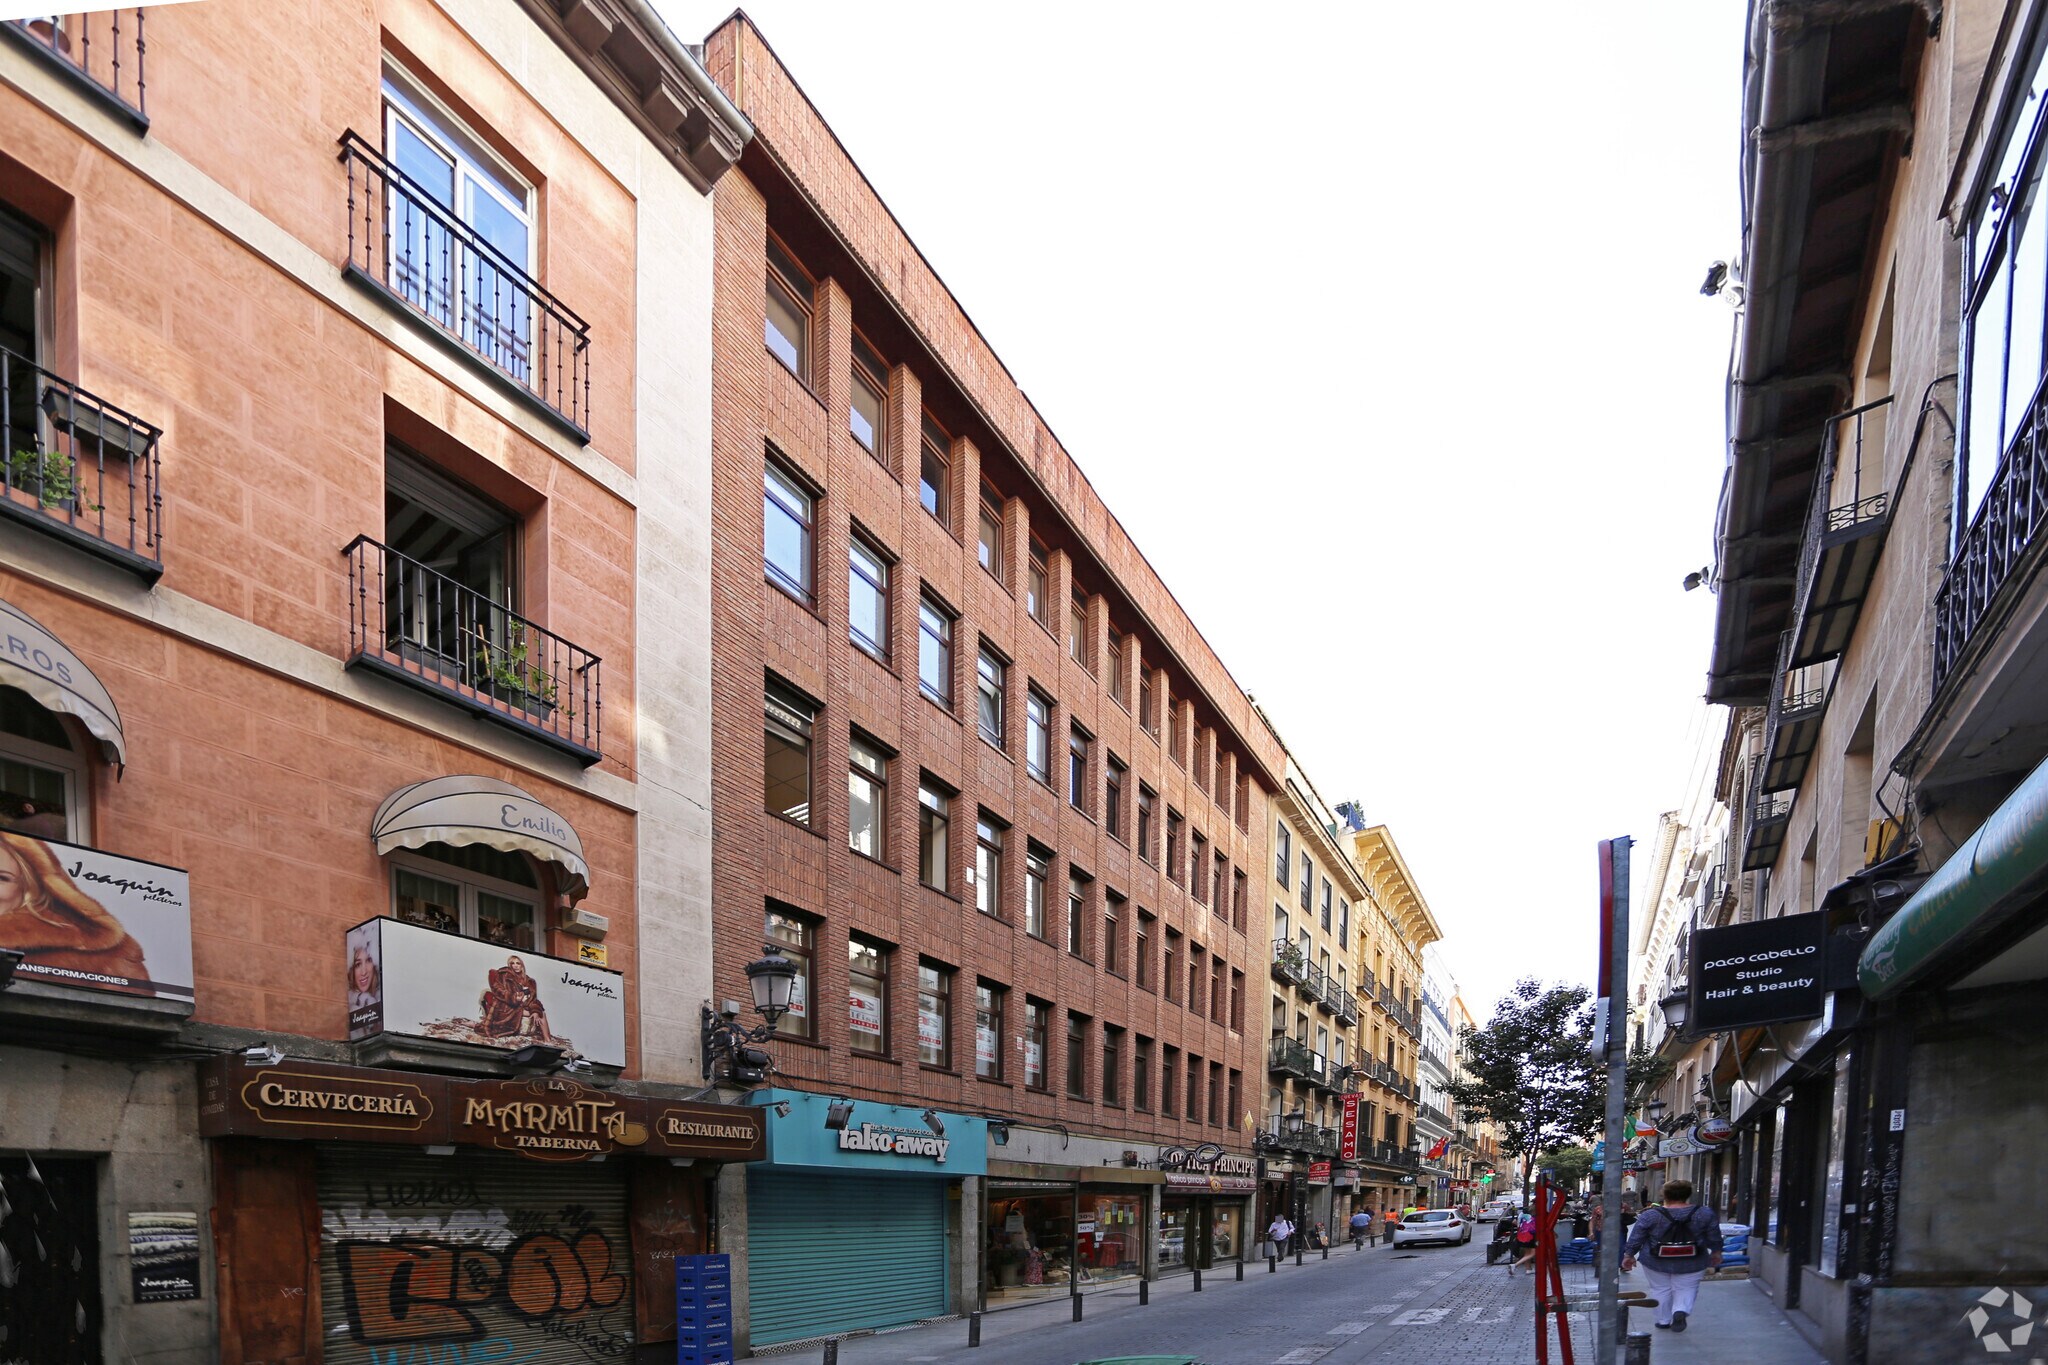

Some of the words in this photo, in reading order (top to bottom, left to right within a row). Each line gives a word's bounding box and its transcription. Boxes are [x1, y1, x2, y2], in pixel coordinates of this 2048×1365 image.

[0, 634, 72, 684] ROS
[501, 804, 567, 841] Emilio
[68, 861, 174, 897] Joaquin
[143, 893, 183, 907] peleteros
[561, 972, 613, 994] Joaquin
[1736, 967, 1783, 980] Studio
[1705, 988, 1738, 1000] Hair
[1742, 985, 1754, 995] &
[1758, 978, 1814, 993] beauty
[549, 1080, 565, 1092] LA
[259, 1082, 419, 1117] CERVECERÍA
[463, 1097, 627, 1140] MARMITA
[667, 1117, 754, 1140] RESTAURANTE
[1343, 1100, 1356, 1159] SESAMO
[514, 1134, 602, 1151] TABERNA
[1214, 1157, 1255, 1174] PRINCIPE
